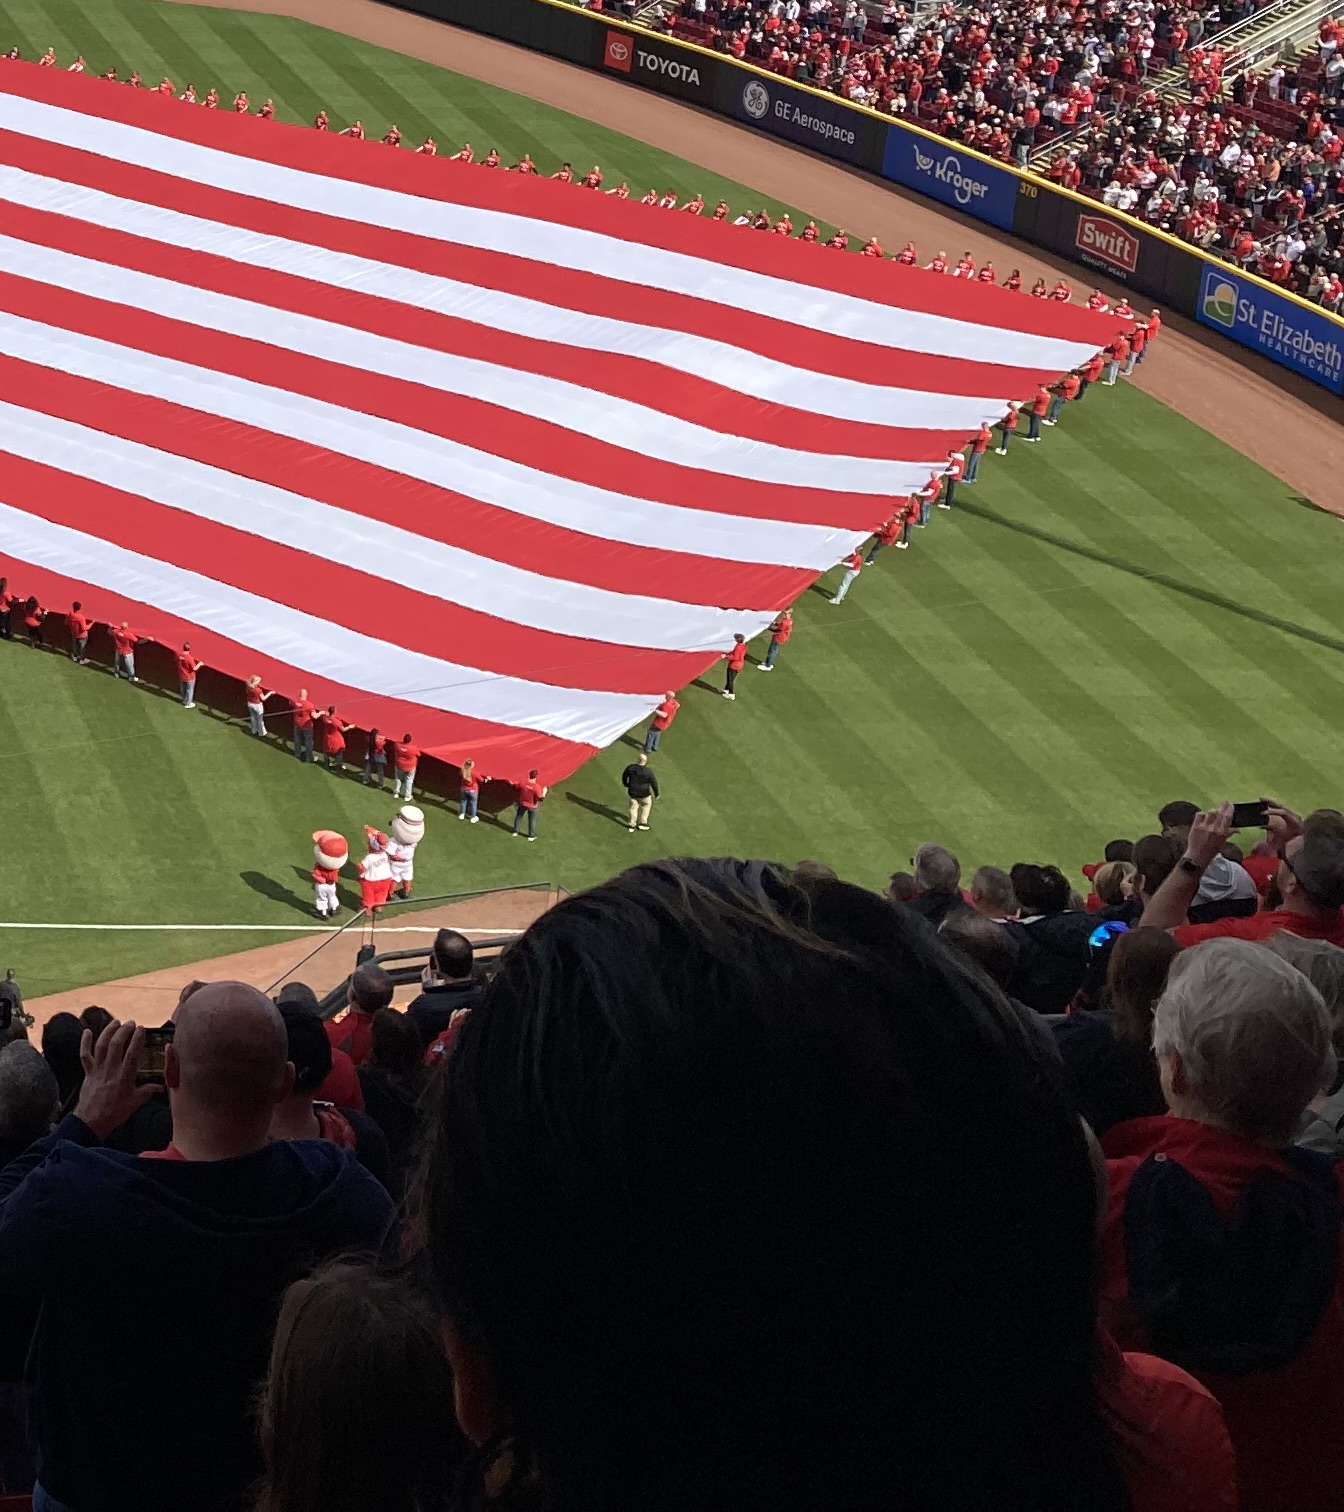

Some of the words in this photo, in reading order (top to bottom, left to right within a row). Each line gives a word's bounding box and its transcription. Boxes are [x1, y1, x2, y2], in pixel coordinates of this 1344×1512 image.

[637, 50, 700, 86] TOYOTA
[774, 100, 792, 121] GE
[792, 107, 855, 144] Aerospace
[935, 156, 989, 204] Kroger
[1019, 181, 1038, 199] 370
[1082, 222, 1131, 262] Swift
[1259, 333, 1339, 382] HEALTHCARE
[1260, 309, 1342, 370] Elizabeth
